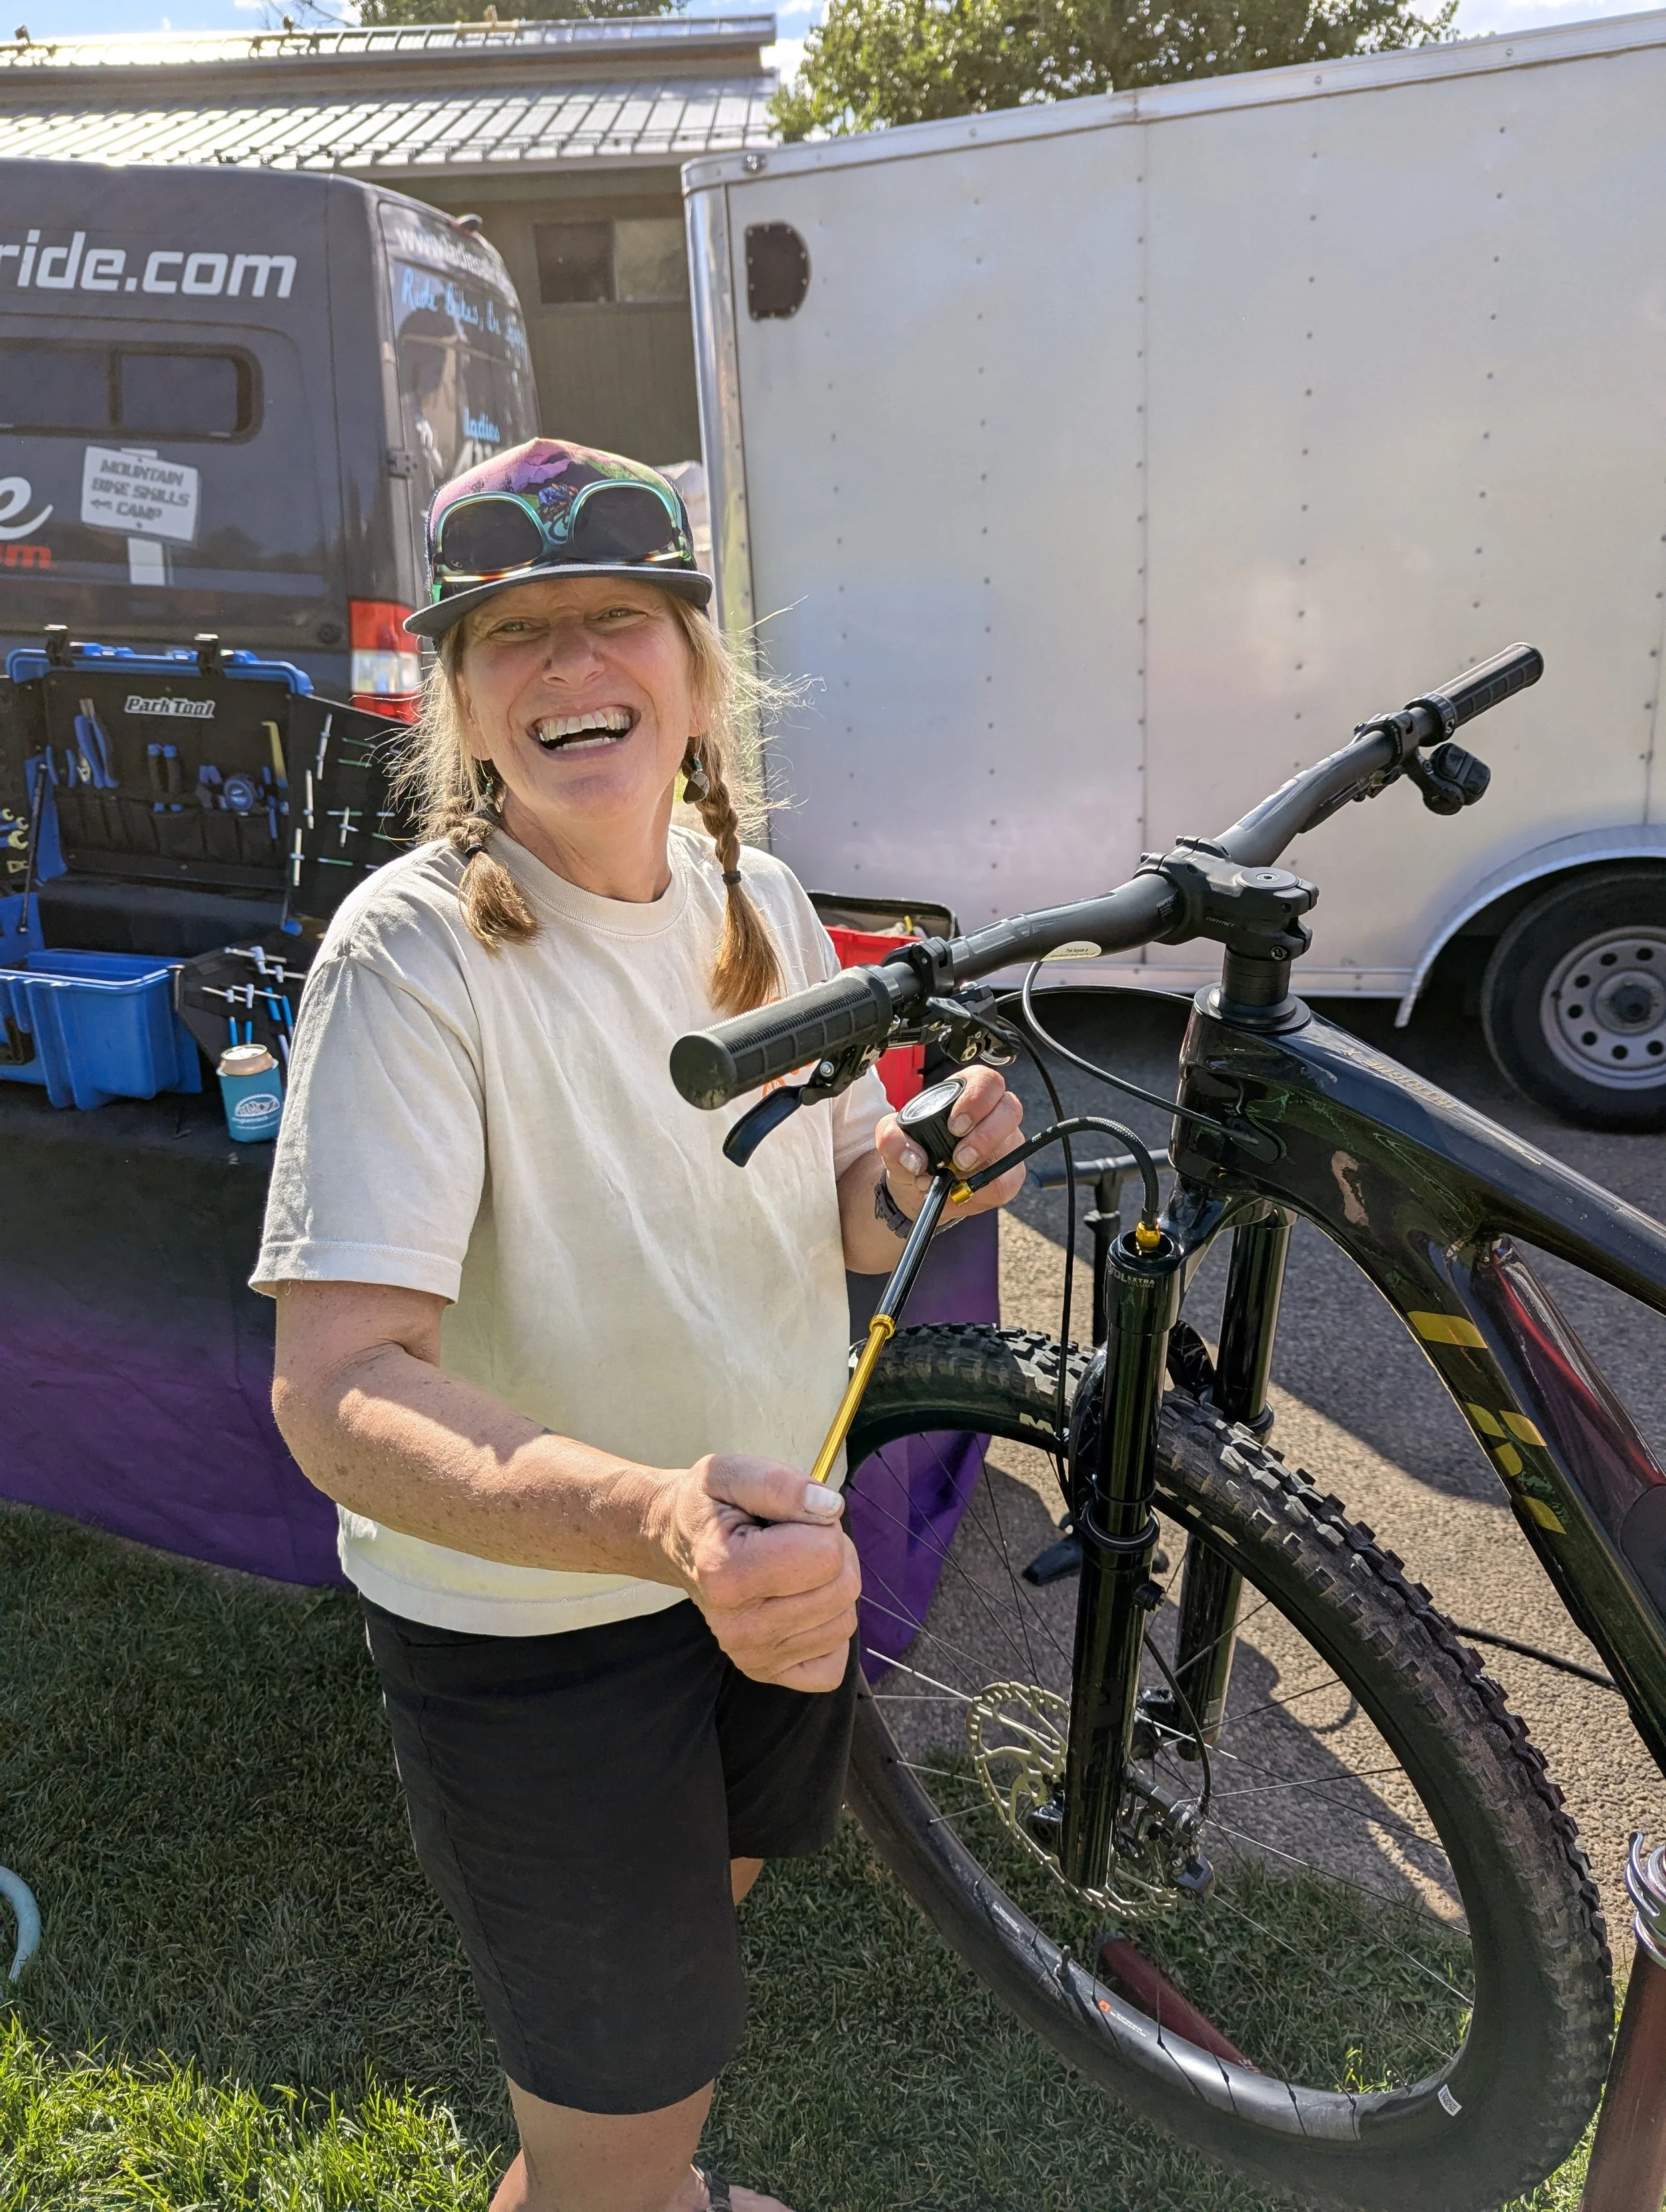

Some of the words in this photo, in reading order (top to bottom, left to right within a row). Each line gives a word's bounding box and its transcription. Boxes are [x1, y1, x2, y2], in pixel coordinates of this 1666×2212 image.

[101, 458, 185, 487] MOUNTAIN
[91, 476, 131, 496] BIKE
[133, 484, 191, 508] SKILLS
[116, 502, 163, 520] CAMP
[1206, 916, 1236, 927] CONTACT
[1128, 1275, 1155, 1285] EXTRA
[1128, 1279, 1156, 1289] VOLUME
